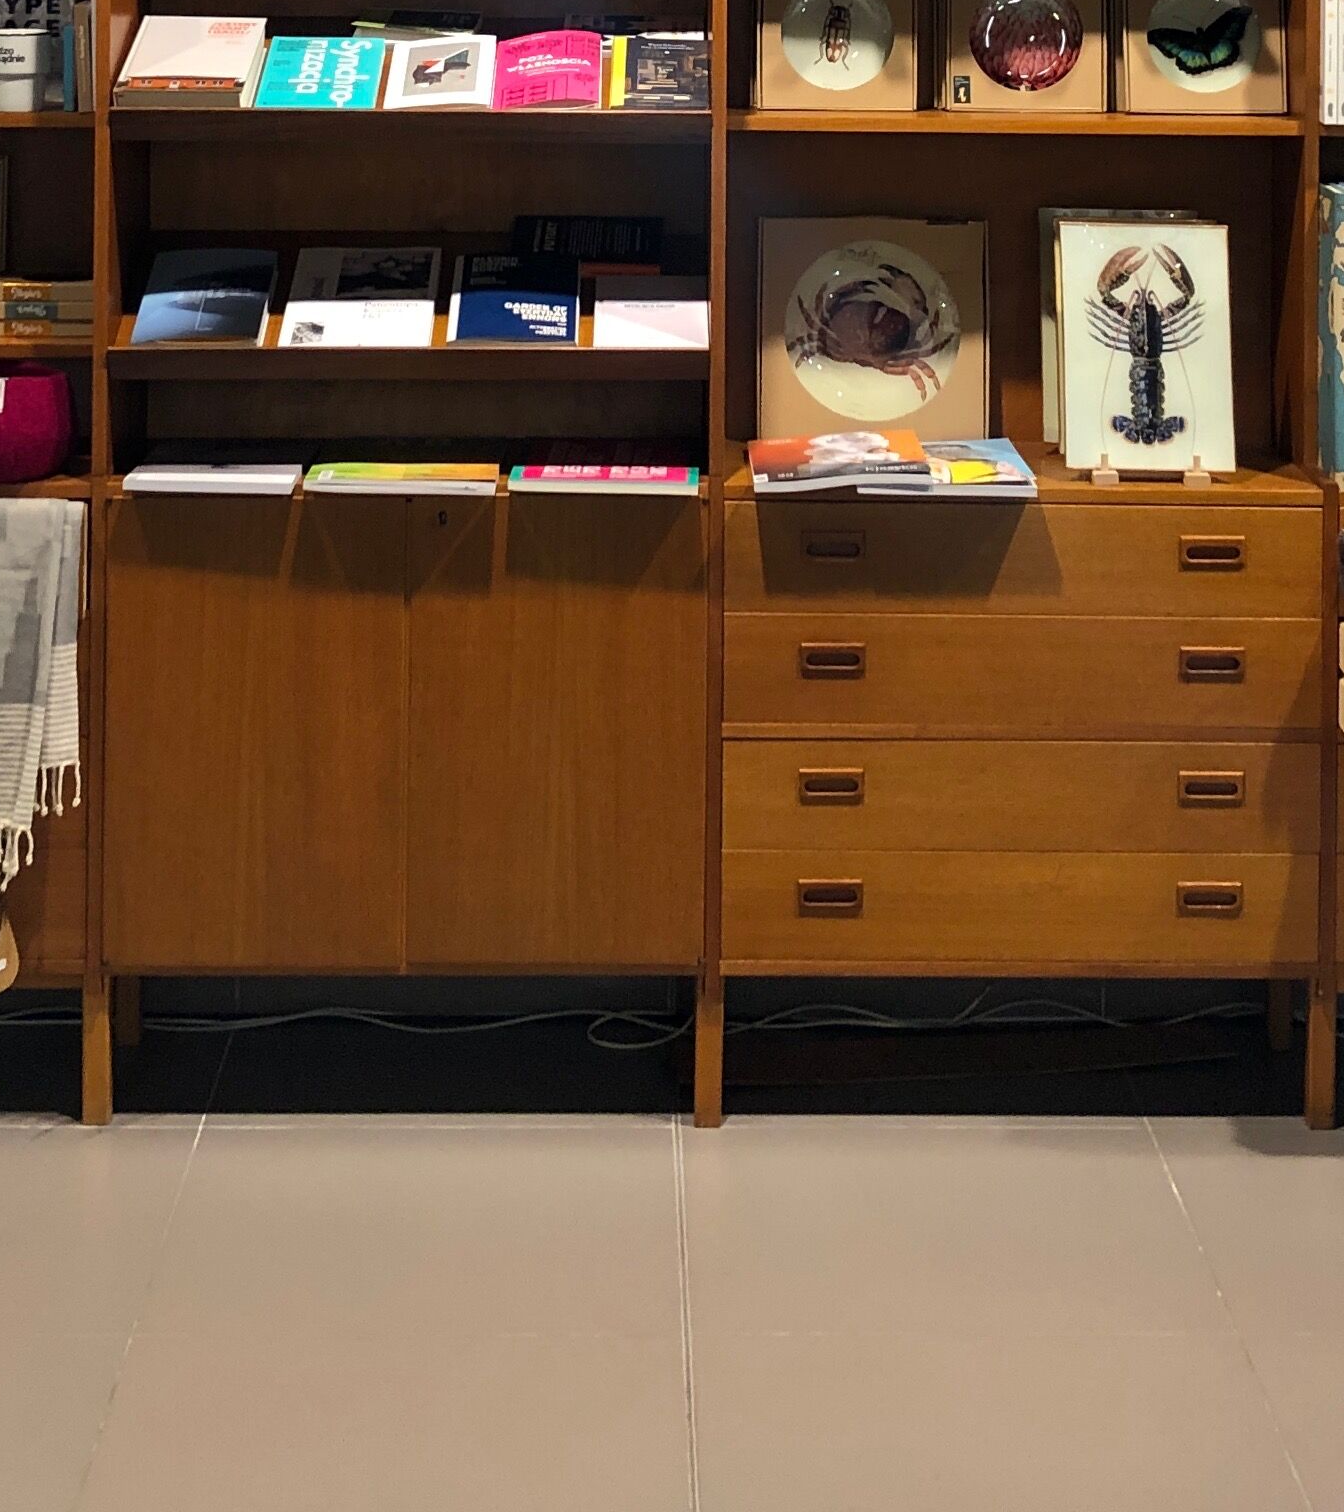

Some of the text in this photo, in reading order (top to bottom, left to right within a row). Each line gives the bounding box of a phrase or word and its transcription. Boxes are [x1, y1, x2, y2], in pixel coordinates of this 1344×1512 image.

[519, 53, 553, 64] POZA
[329, 39, 373, 109] Synchro-
[504, 301, 552, 311] GARDEN
